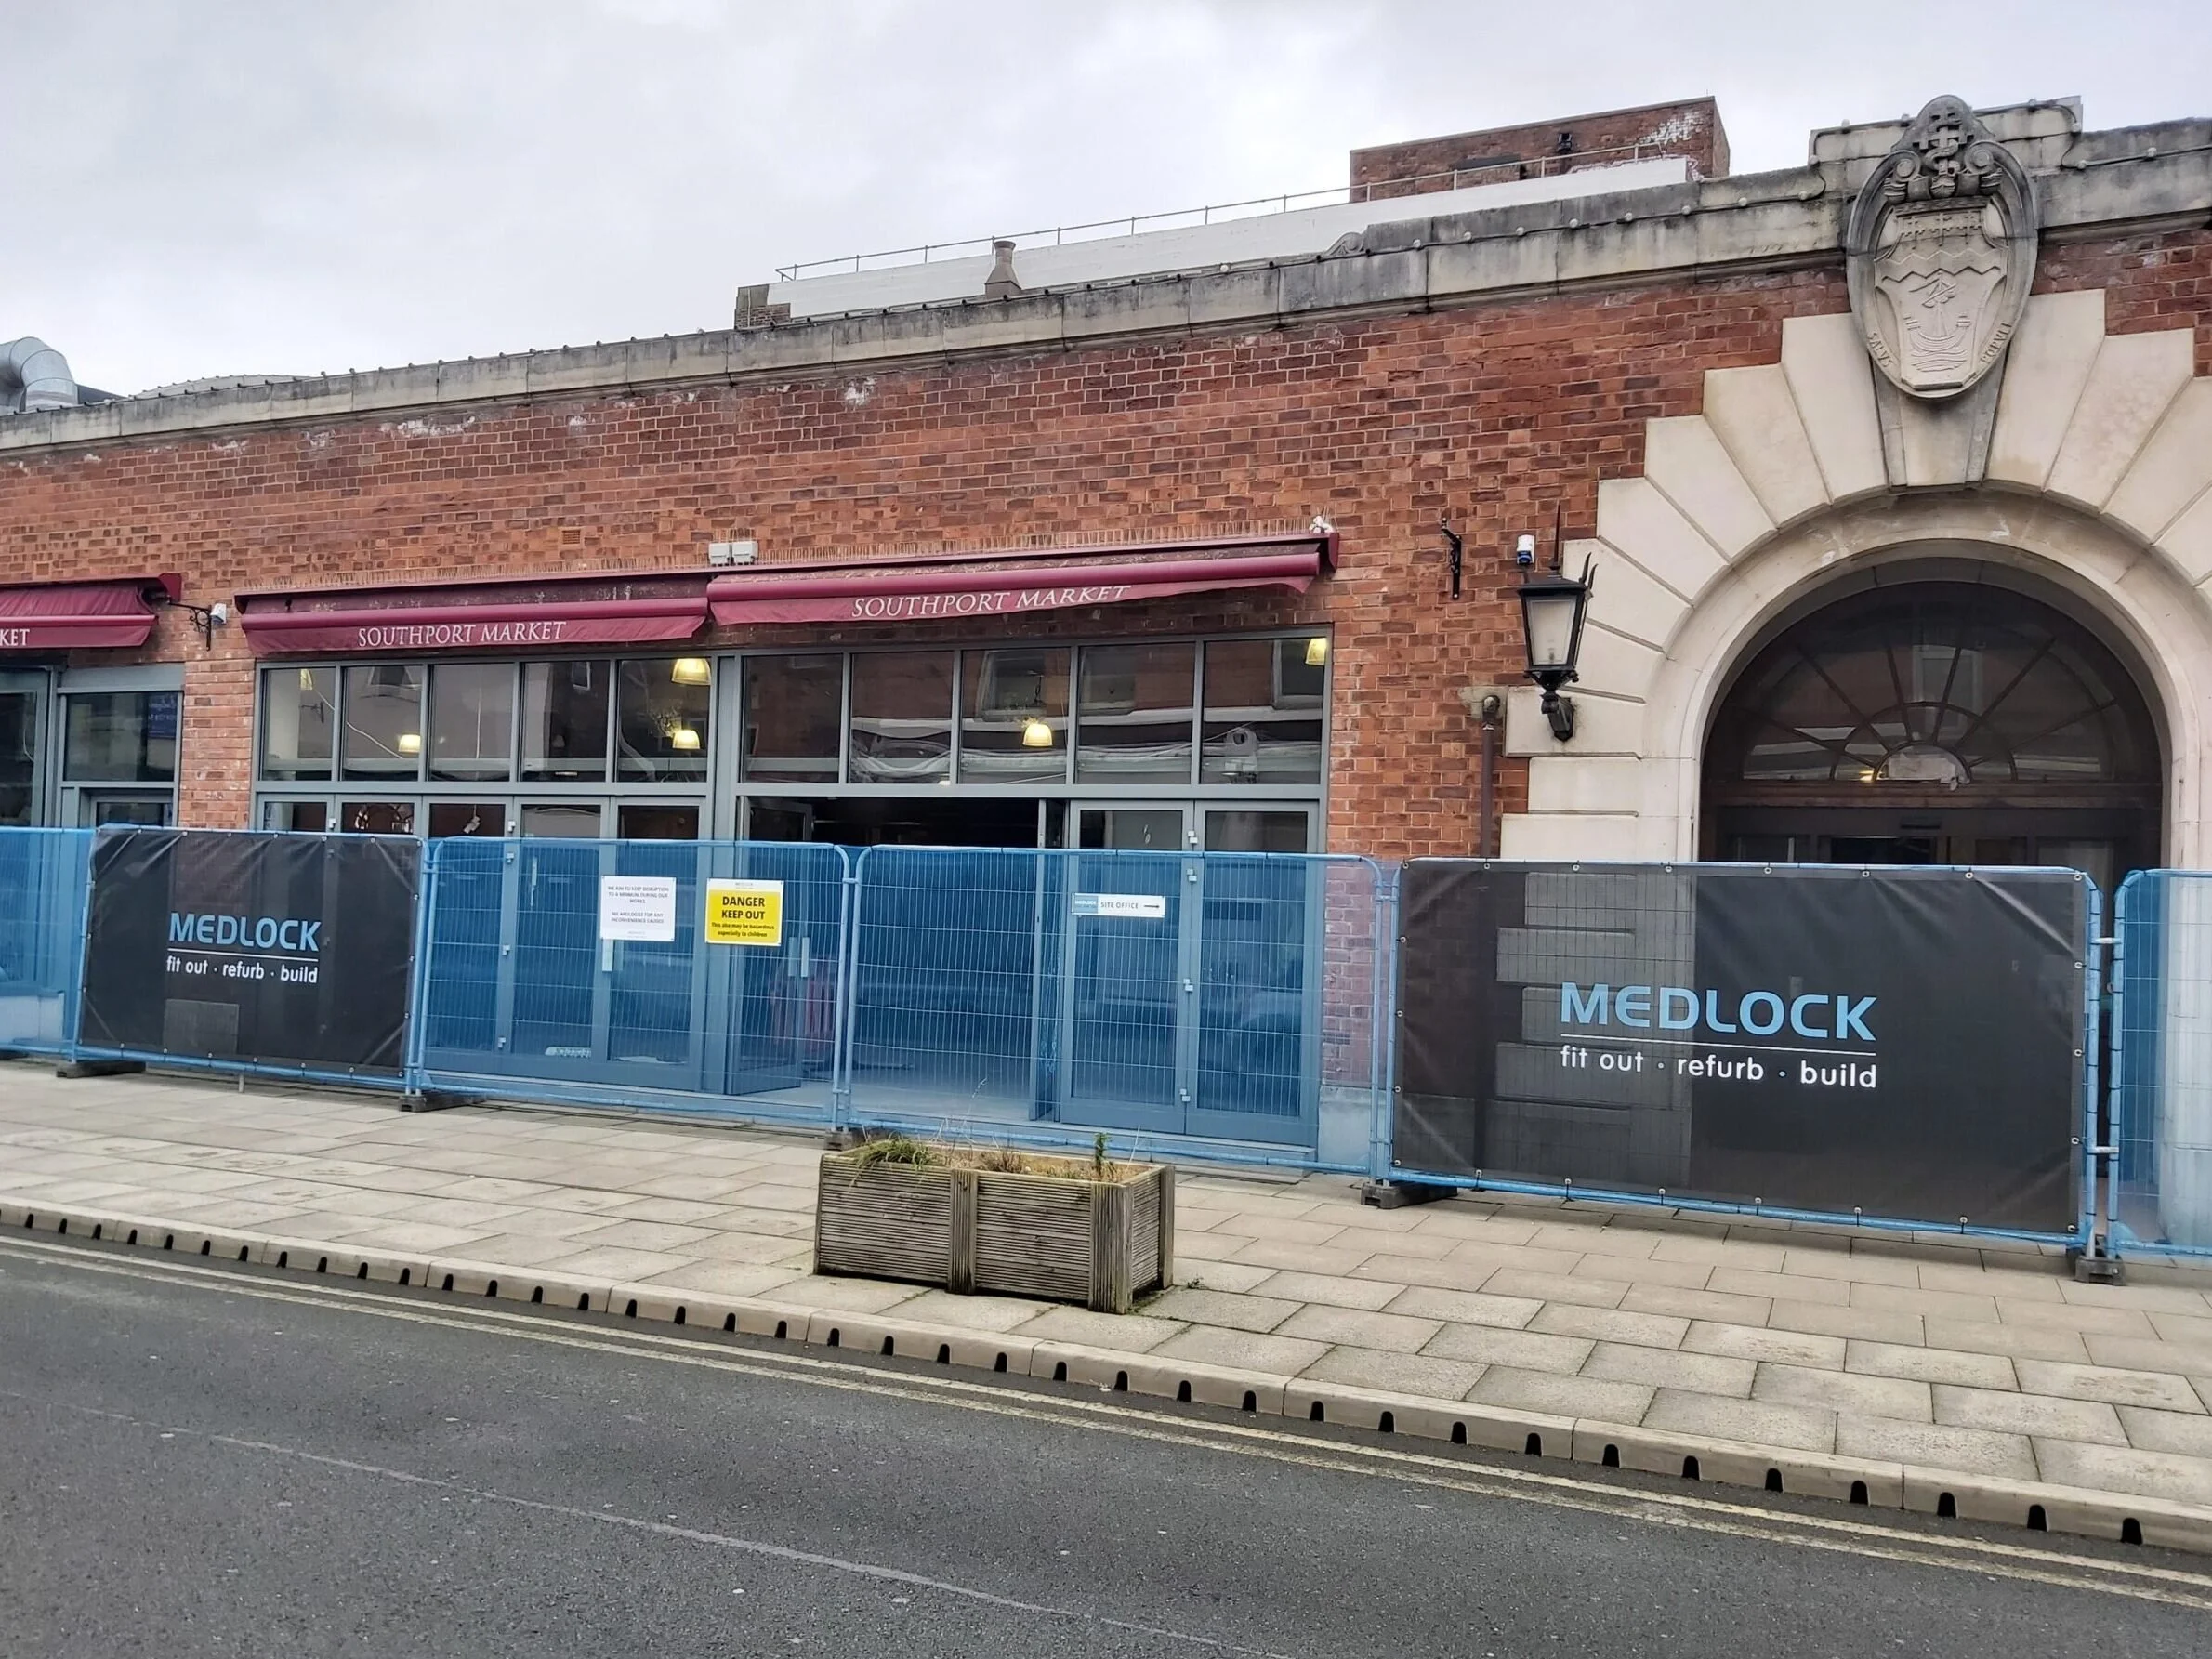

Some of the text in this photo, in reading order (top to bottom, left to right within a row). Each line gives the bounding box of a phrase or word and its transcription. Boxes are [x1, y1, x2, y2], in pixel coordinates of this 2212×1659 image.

[851, 585, 1132, 617] SOUTHPORT MARKET
[358, 620, 567, 647] SOUTHPORT MARKET
[721, 909, 766, 920] KEEP OUT
[722, 896, 766, 907] DANGER
[1115, 902, 1139, 910] OFFICE
[168, 912, 322, 952] MEDLOCK
[165, 955, 319, 984] fit out refurb build
[1560, 981, 1877, 1041] MEDLOCK
[1560, 1045, 1877, 1089] fit out refurb build
